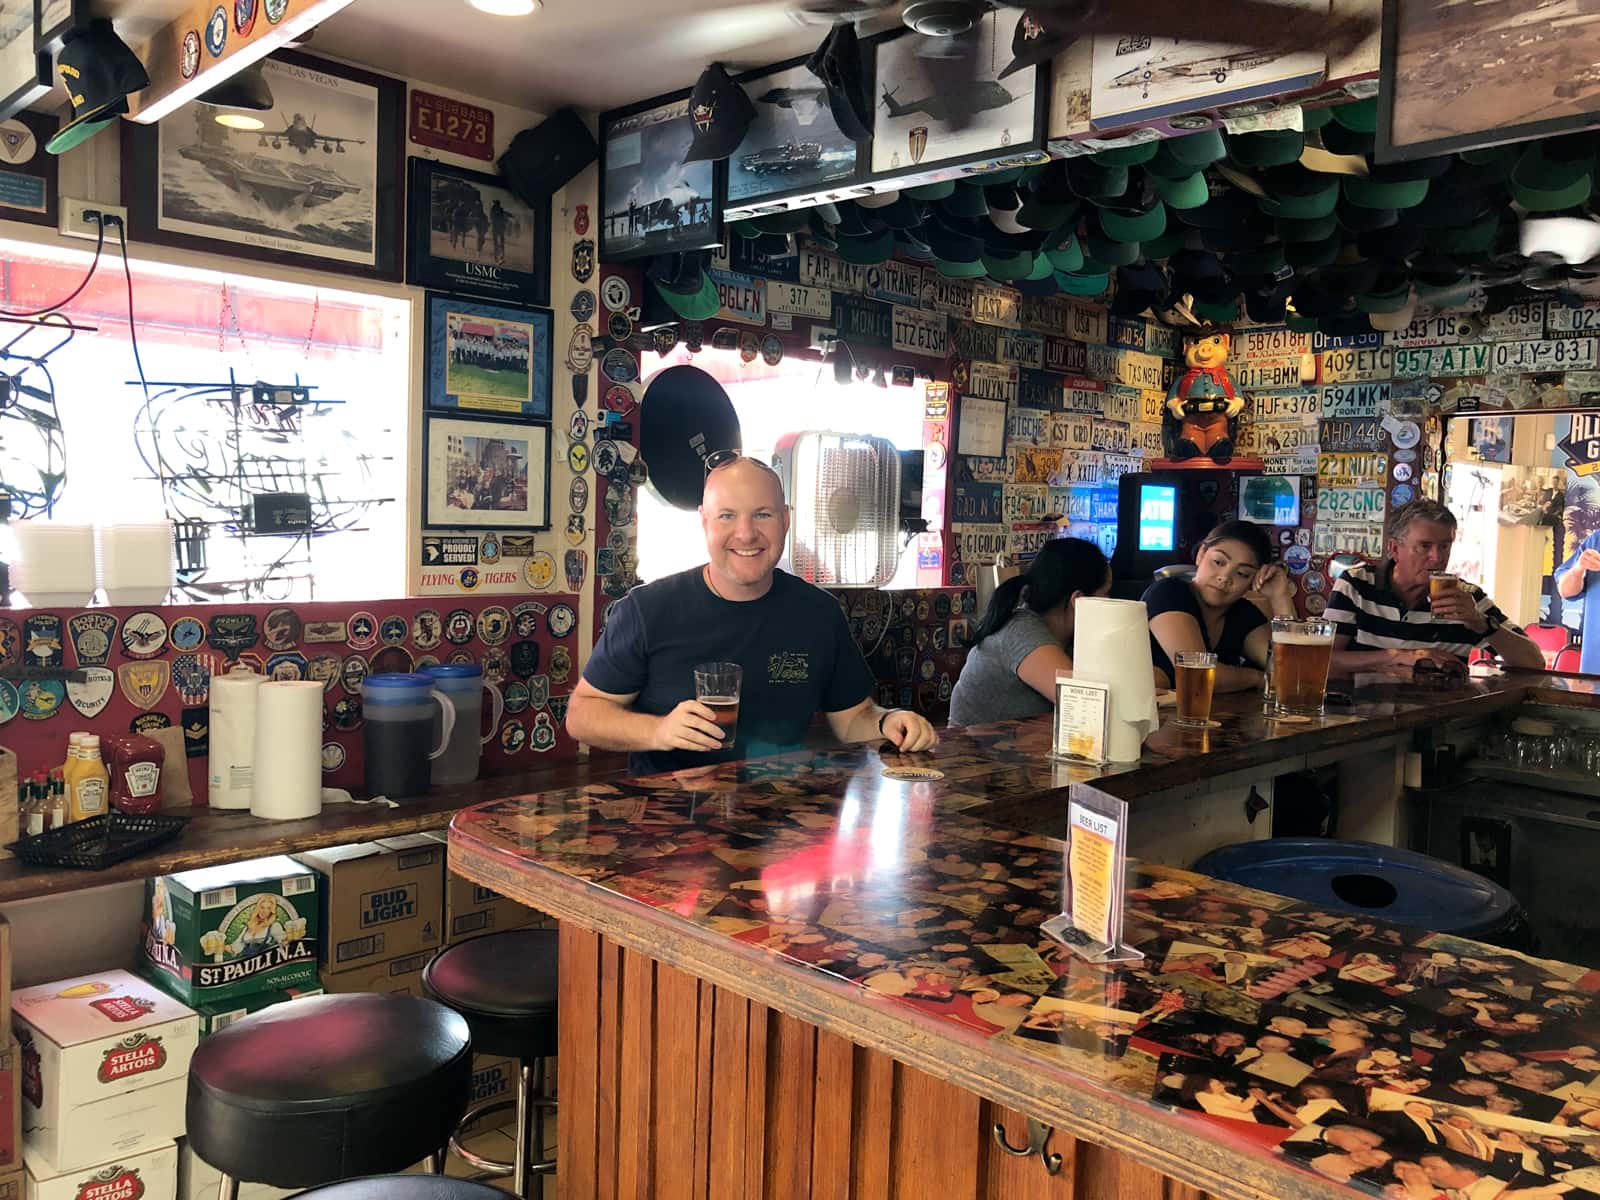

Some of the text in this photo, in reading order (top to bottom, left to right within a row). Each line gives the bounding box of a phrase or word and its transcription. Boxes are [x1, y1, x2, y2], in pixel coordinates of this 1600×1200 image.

[288, 66, 305, 79] LAS
[308, 71, 338, 87] VEGAS
[418, 107, 491, 144] E1273
[464, 262, 503, 280] USMC
[806, 254, 832, 280] FAR
[884, 267, 920, 297] TRANE
[789, 287, 808, 307] 377
[1002, 337, 1040, 364] AWSOME
[1046, 343, 1062, 365] LUV
[1109, 395, 1137, 417] TOMATO
[1321, 421, 1386, 442] AHD 446
[1264, 456, 1287, 465] MONEY
[443, 543, 476, 553] PROUDLY
[444, 553, 475, 563] SERVED!
[419, 571, 519, 587] FLYING TIGERS
[72, 615, 114, 627] BOSTON
[77, 622, 109, 633] POLICE
[75, 697, 106, 709] SECURITY
[1079, 813, 1108, 835] BEER LIST
[370, 888, 408, 910] BUD
[362, 901, 415, 925] LIGHT
[422, 920, 433, 936] 4
[223, 950, 272, 983] PAULI
[276, 940, 313, 963] N.A.
[112, 999, 140, 1016] STELLA
[109, 1056, 156, 1076] ARTOIS
[110, 1047, 155, 1067] STELLA
[86, 1178, 133, 1199] STELLA
[87, 1186, 134, 1200] ARTOIS
